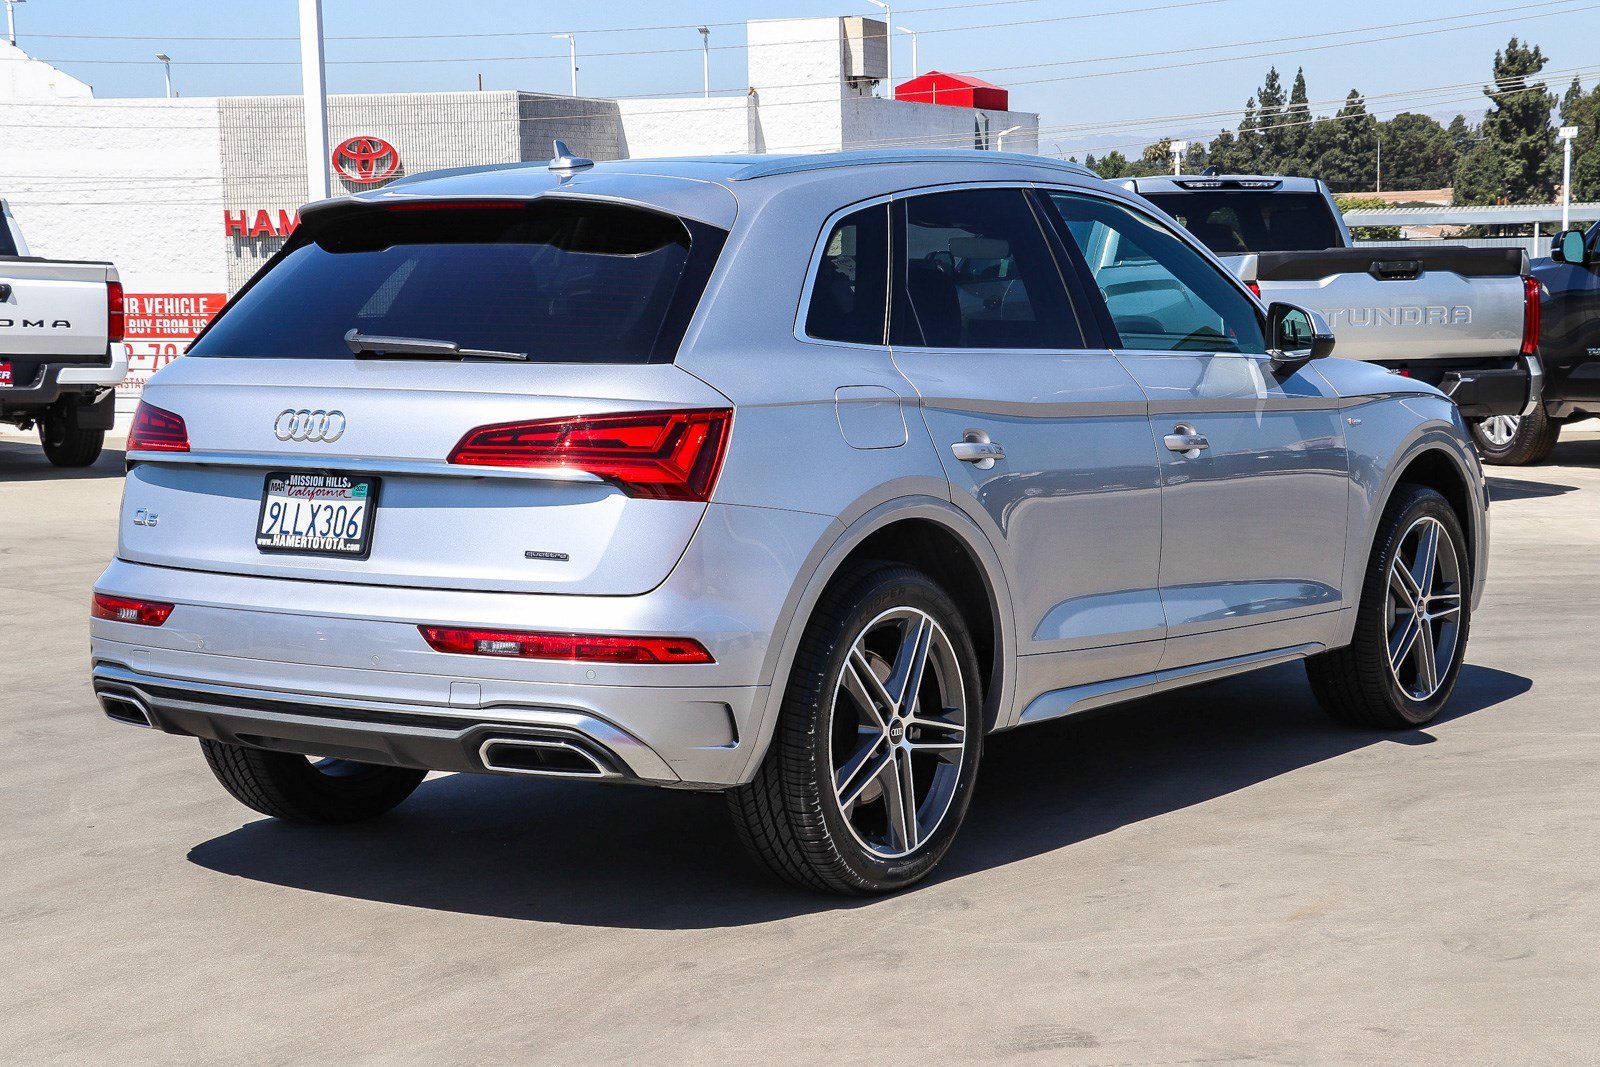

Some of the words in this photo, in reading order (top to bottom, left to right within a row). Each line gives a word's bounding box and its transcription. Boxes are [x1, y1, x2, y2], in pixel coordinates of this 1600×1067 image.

[143, 297, 209, 316] VEHICLE
[1322, 305, 1472, 328] TUNDRA
[128, 319, 153, 334] BUY
[156, 319, 190, 334] FROM
[289, 474, 324, 487] MISSION
[325, 475, 348, 488] HILLS
[287, 481, 351, 502] California
[265, 501, 363, 539] 9LLX306
